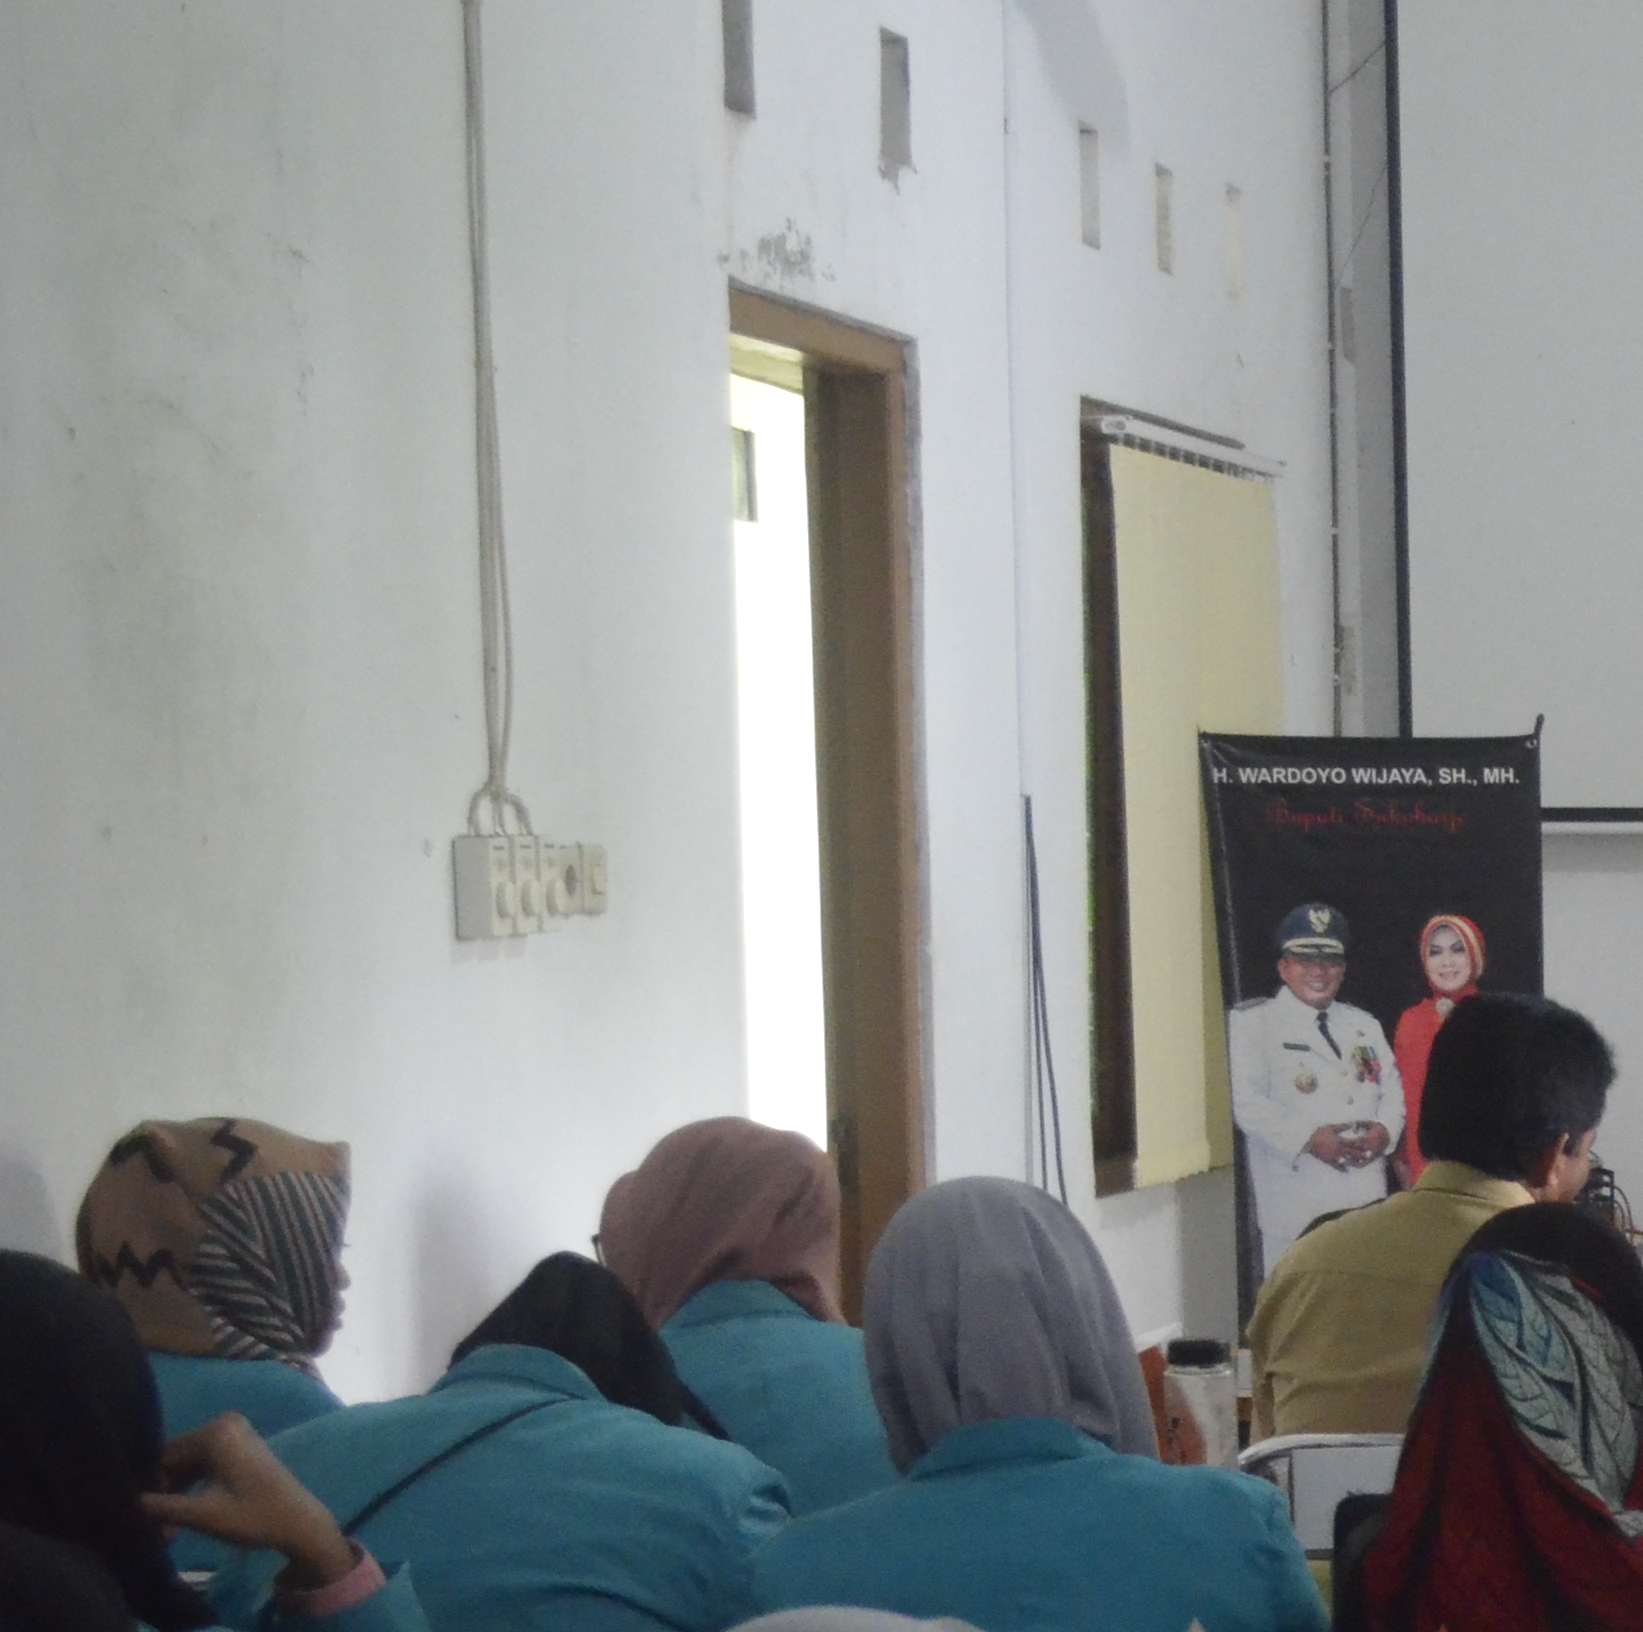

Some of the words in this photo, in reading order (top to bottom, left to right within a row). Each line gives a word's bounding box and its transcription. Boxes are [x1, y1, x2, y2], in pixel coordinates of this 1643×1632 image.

[1212, 767, 1234, 785] H.
[1239, 767, 1347, 785] WARDOYO
[1351, 767, 1433, 787] WIJAYA,
[1482, 767, 1521, 785] MH.
